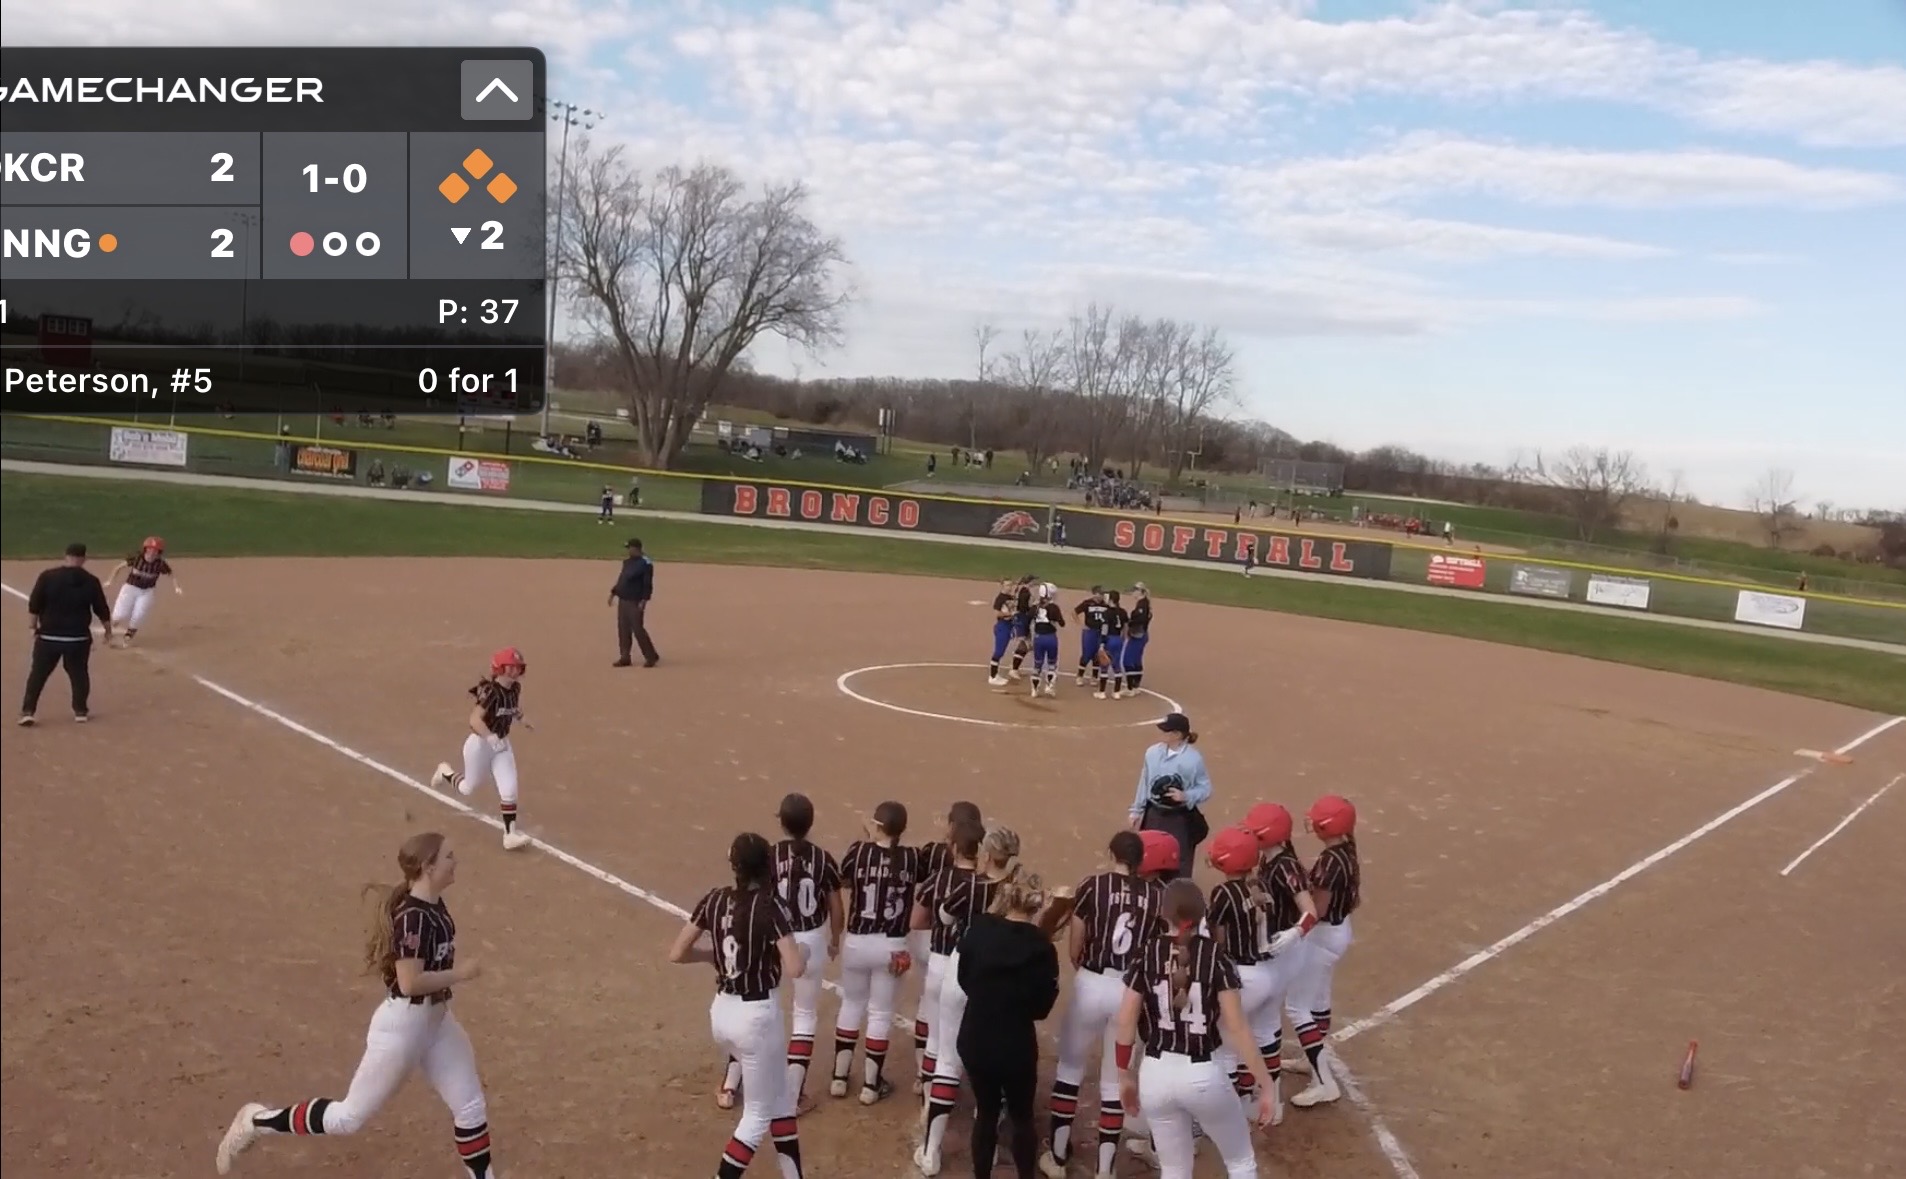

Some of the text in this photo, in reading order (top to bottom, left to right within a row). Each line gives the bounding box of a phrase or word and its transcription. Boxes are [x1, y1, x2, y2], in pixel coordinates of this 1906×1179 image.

[733, 485, 920, 528] BRONCO
[861, 883, 907, 920] 15
[1112, 911, 1137, 955] 6
[1152, 979, 1208, 1035] 14
